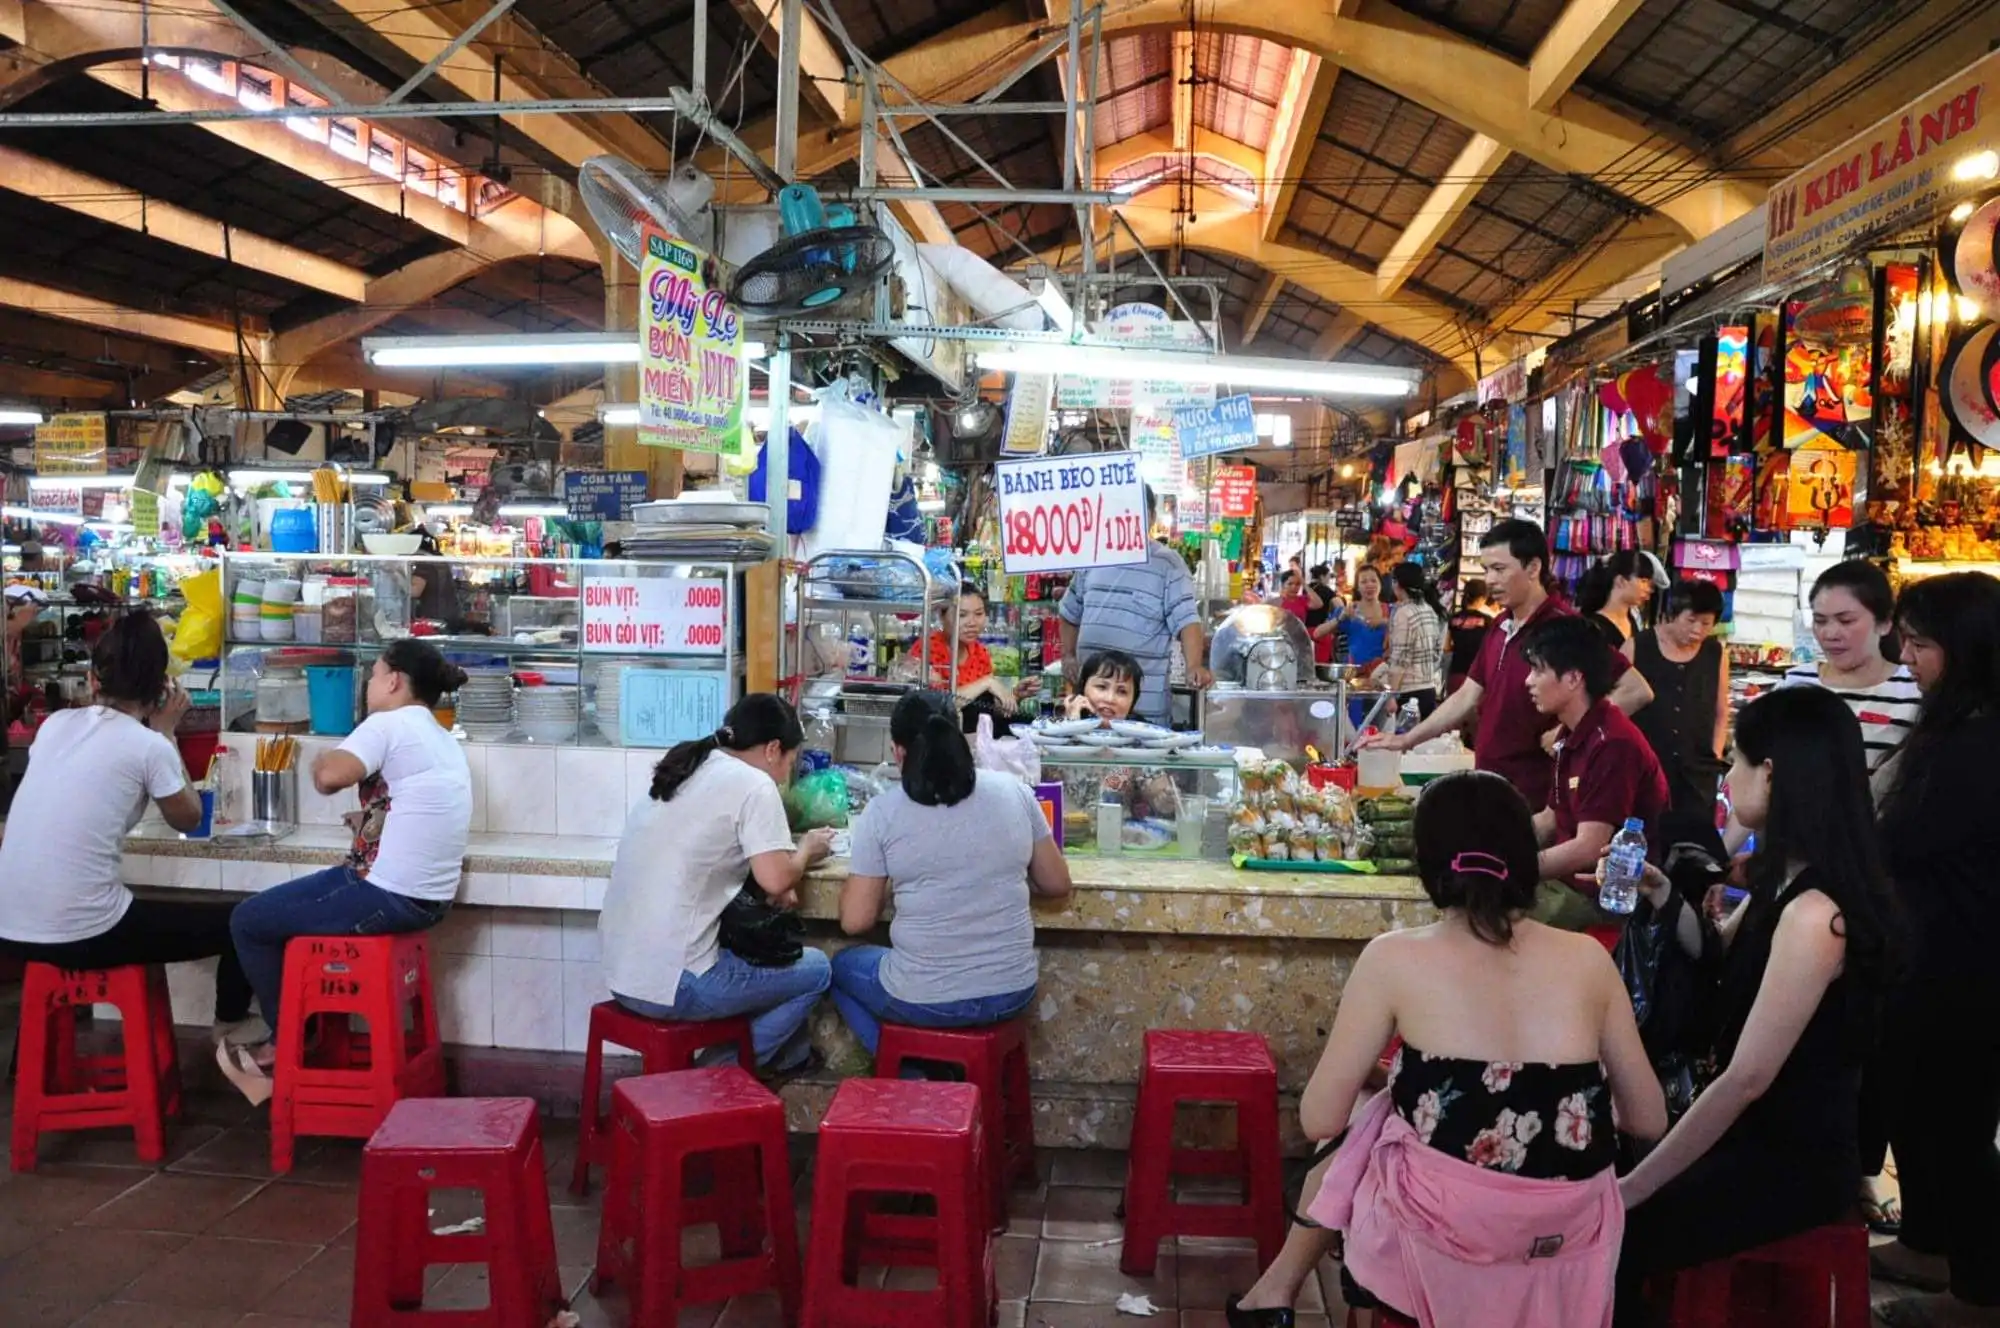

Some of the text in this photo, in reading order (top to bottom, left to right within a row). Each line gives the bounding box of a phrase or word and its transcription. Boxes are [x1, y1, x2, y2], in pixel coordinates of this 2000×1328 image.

[1804, 154, 1862, 216] KIM
[1003, 466, 1054, 495] BÁNH
[585, 580, 612, 607] BÚN
[615, 586, 639, 612] VỊT:
[585, 617, 612, 644] BÚN
[615, 615, 637, 644] GỎI
[640, 624, 665, 649] VỊT:
